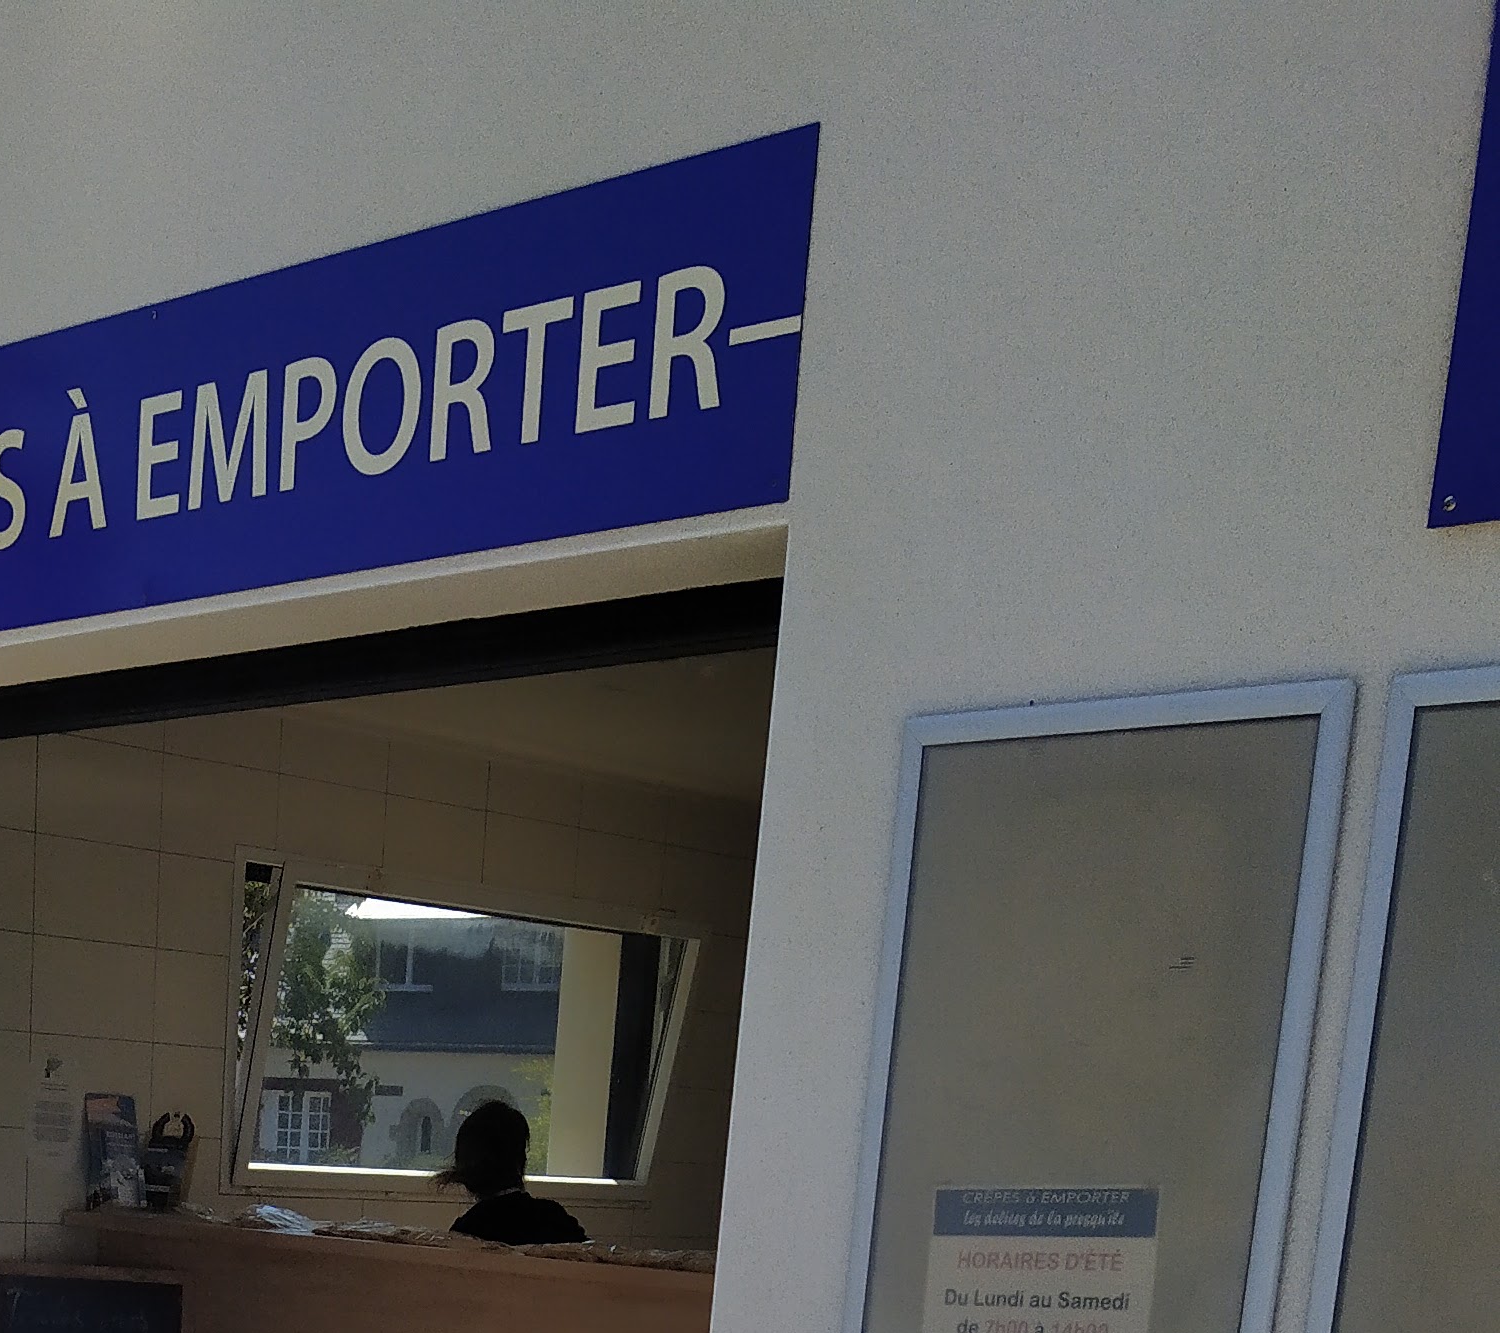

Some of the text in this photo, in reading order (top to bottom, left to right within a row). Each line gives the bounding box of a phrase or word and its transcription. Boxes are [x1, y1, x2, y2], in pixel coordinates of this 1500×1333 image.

[49, 387, 107, 539] À
[134, 264, 728, 521] EMPORTER
[1041, 1191, 1130, 1205] EMPORTER
[1028, 1210, 1044, 1226] de
[1046, 1210, 1063, 1226] la
[956, 1248, 1125, 1273] HORAIRES D'ÉTÉ
[944, 1288, 1130, 1311] Du Lundi au Samedi
